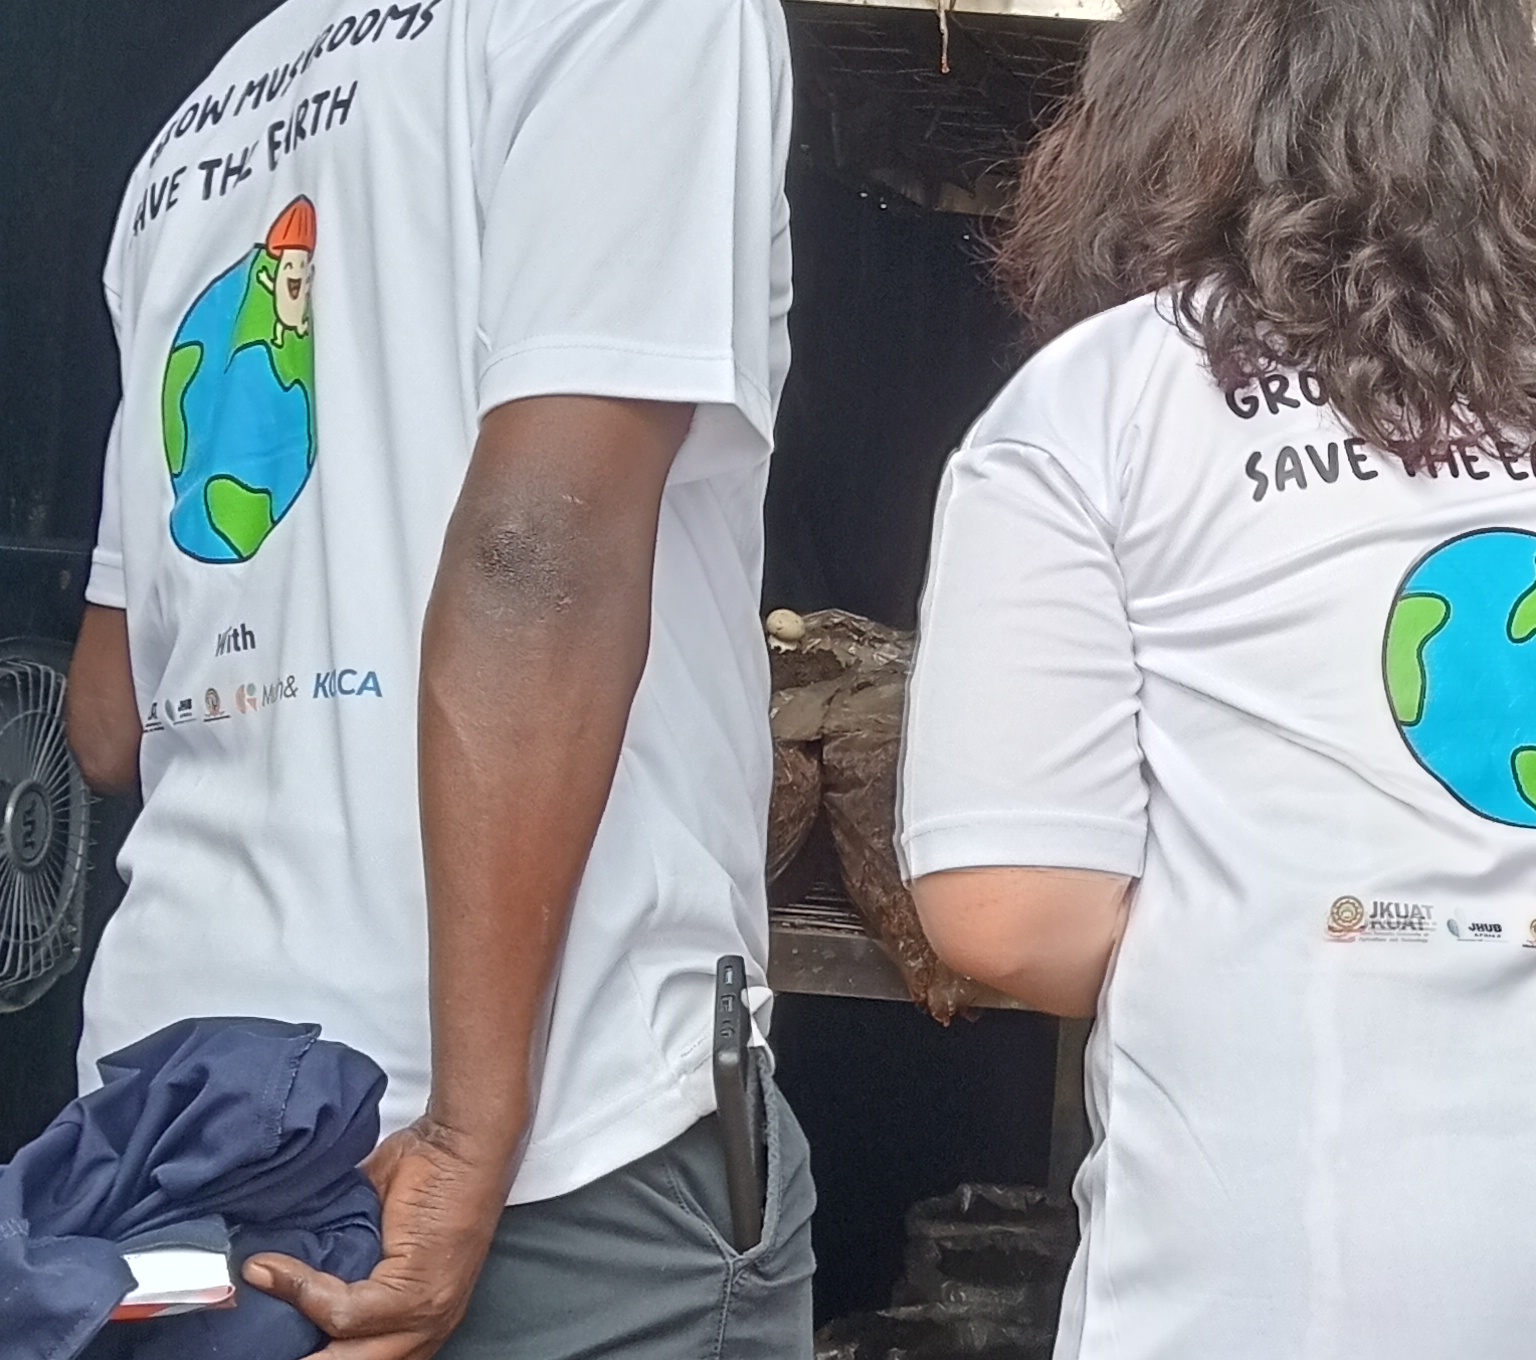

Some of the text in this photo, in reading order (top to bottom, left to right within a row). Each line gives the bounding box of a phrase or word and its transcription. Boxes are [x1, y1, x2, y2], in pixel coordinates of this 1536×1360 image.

[133, 165, 187, 237] AVE
[1225, 371, 1329, 419] GRO
[1245, 437, 1379, 502] SAVE
[1369, 900, 1434, 921] JKUAT
[1468, 922, 1503, 933] JHUB
